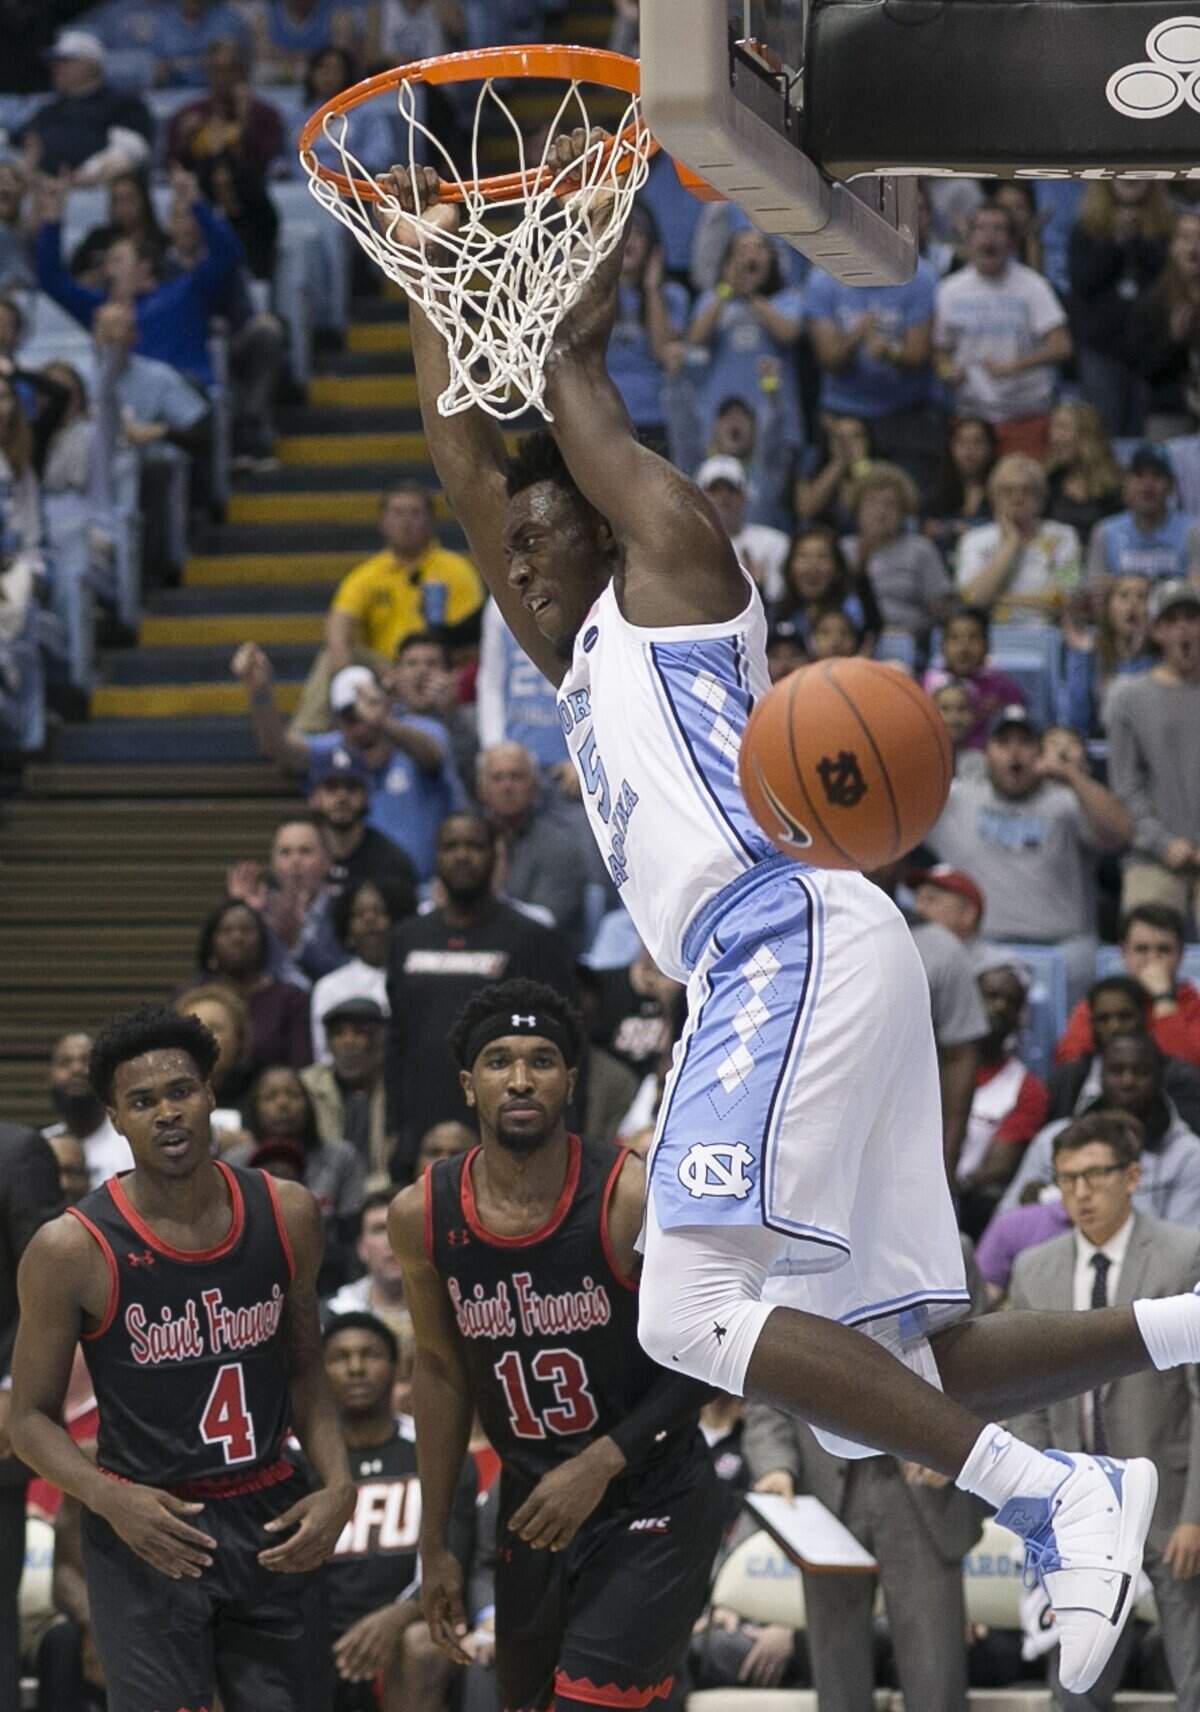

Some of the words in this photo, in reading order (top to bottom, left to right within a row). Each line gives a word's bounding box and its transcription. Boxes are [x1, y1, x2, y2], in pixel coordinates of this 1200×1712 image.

[577, 726, 611, 824] 5
[126, 1299, 203, 1364] Saint
[512, 1272, 611, 1336] Francis
[199, 1362, 257, 1465] 4
[494, 1348, 599, 1439] 13
